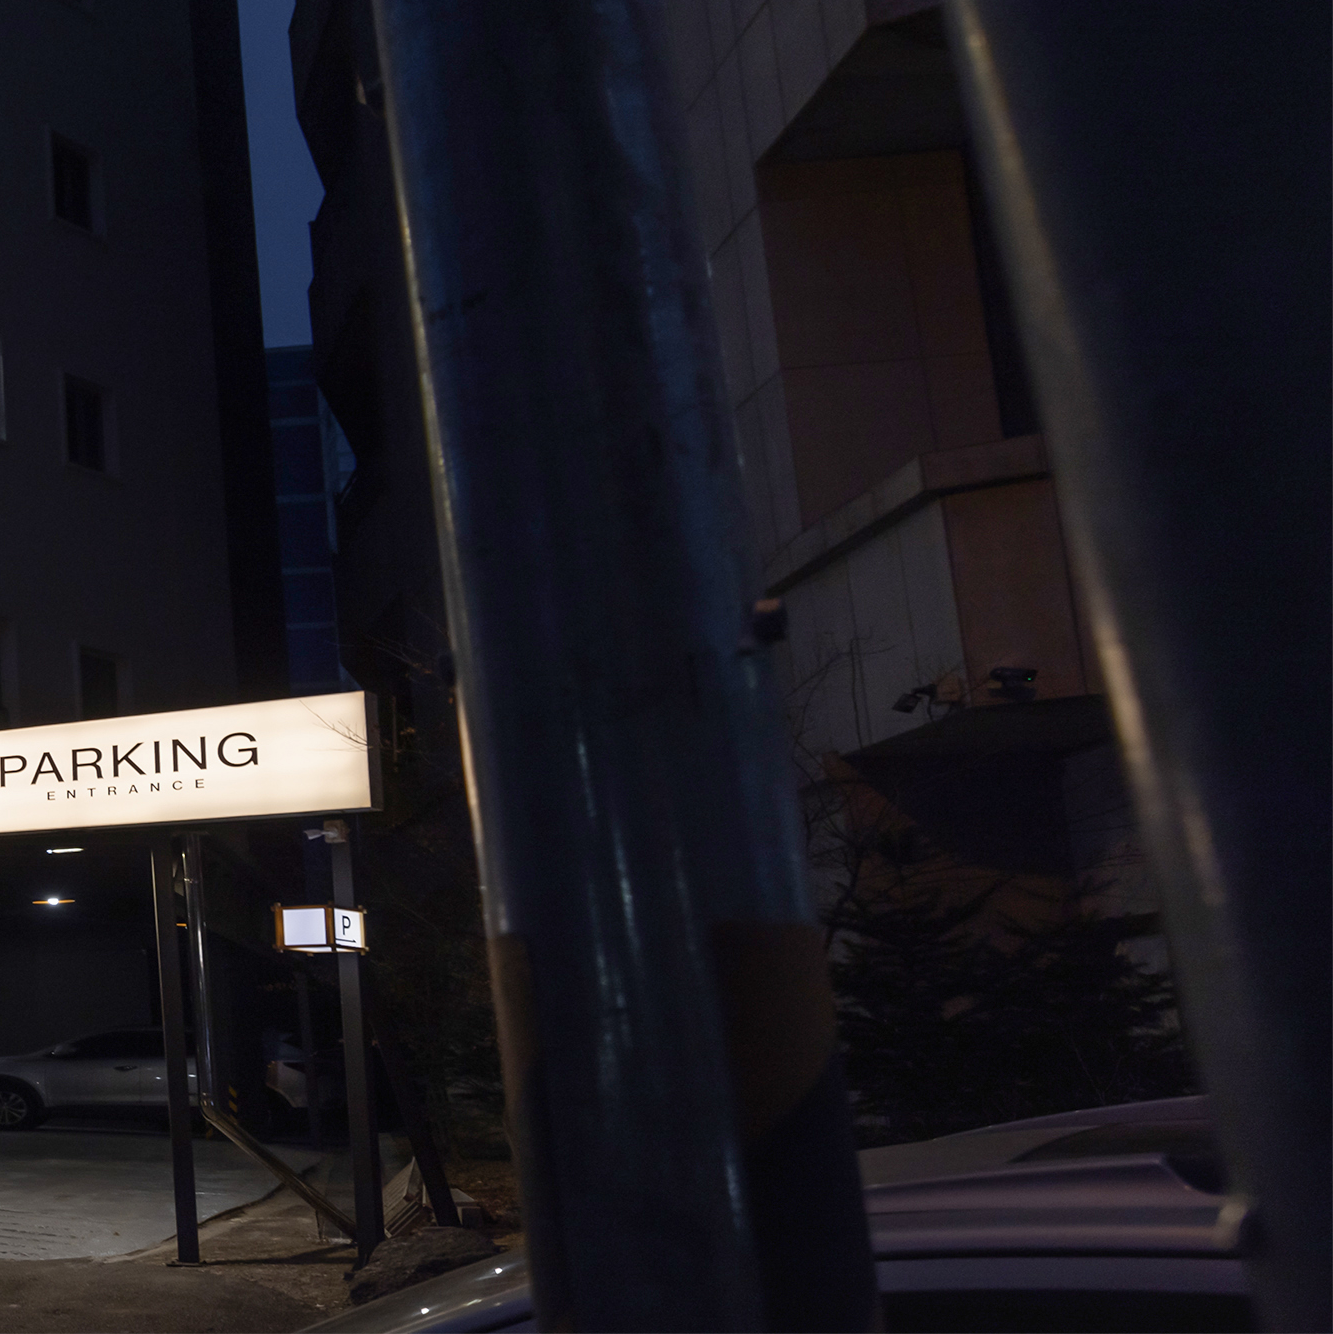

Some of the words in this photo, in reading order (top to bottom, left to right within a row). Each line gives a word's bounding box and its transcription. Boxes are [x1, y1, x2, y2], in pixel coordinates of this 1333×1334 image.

[0, 732, 259, 788] PARKING
[47, 778, 205, 801] ENTRANCE
[341, 915, 351, 935] P
